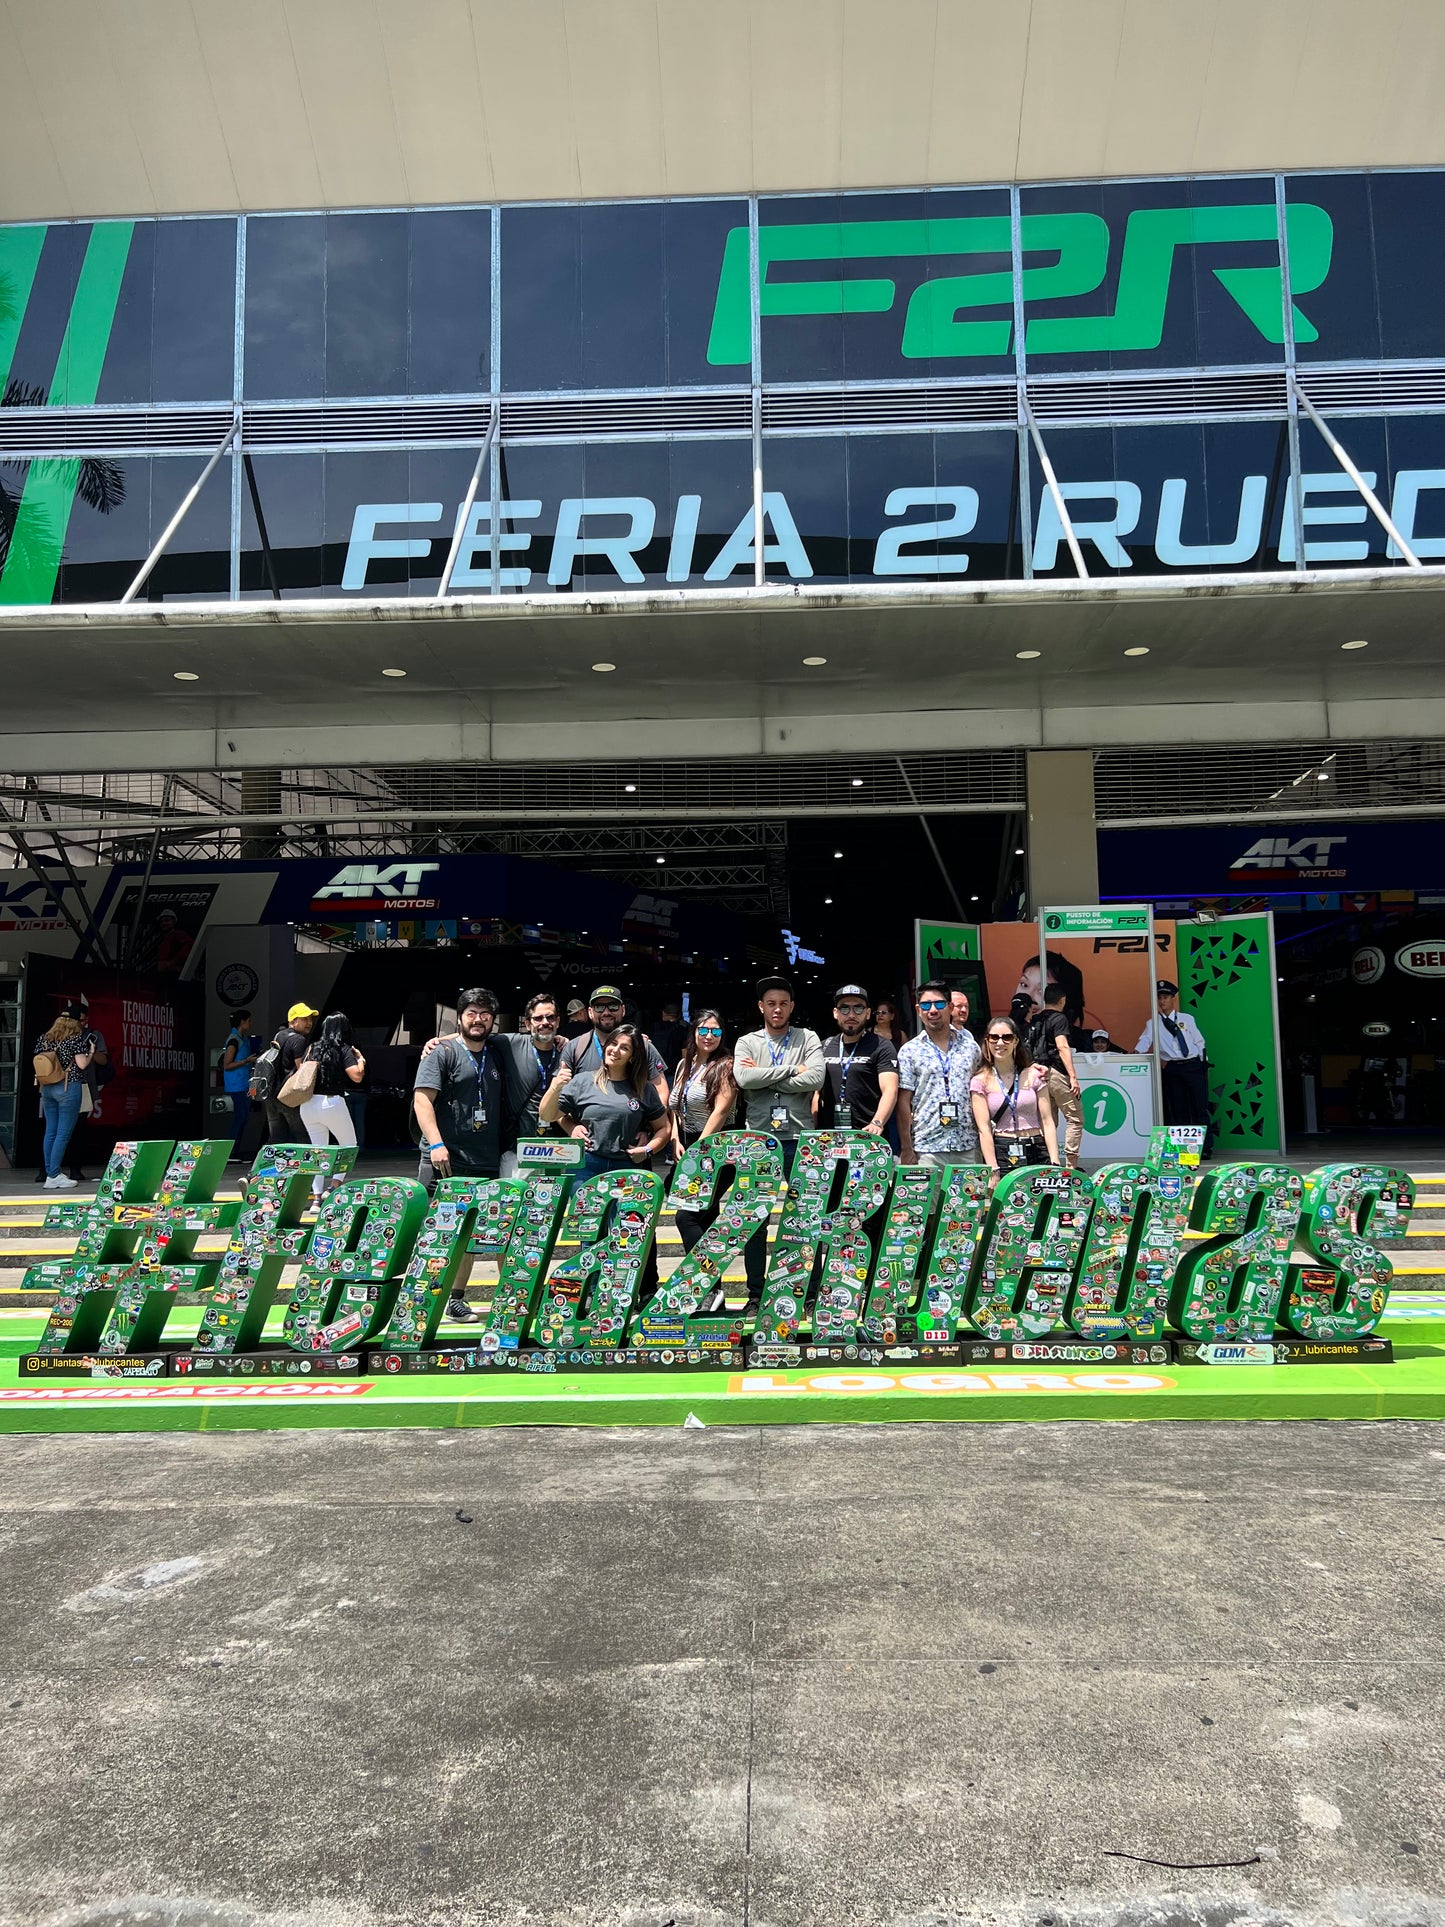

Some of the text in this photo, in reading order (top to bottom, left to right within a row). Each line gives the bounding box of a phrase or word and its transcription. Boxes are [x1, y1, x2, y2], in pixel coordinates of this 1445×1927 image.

[706, 203, 1333, 365] F2R
[341, 491, 814, 590] FERIA
[873, 486, 979, 575] 2
[1229, 836, 1347, 869] AKT
[312, 863, 440, 898] AKT
[1298, 869, 1347, 877] MOTOS
[125, 892, 211, 903] KRGUERO
[384, 900, 435, 909] MOTOS
[1066, 917, 1113, 925] INFORMACIÓN
[1117, 916, 1147, 924] F2R
[1093, 934, 1171, 953] F2R
[1355, 957, 1376, 976] BELL
[122, 1000, 174, 1028] TECNOLOGÍA
[122, 1023, 173, 1049] Y RESPALDO
[122, 1046, 195, 1072] AL MEJOR PRECIO
[1120, 1065, 1148, 1073] F2R
[1176, 1128, 1198, 1137] 122
[1034, 1178, 1070, 1188] FELLAZ
[741, 1373, 1167, 1392] LOGRO
